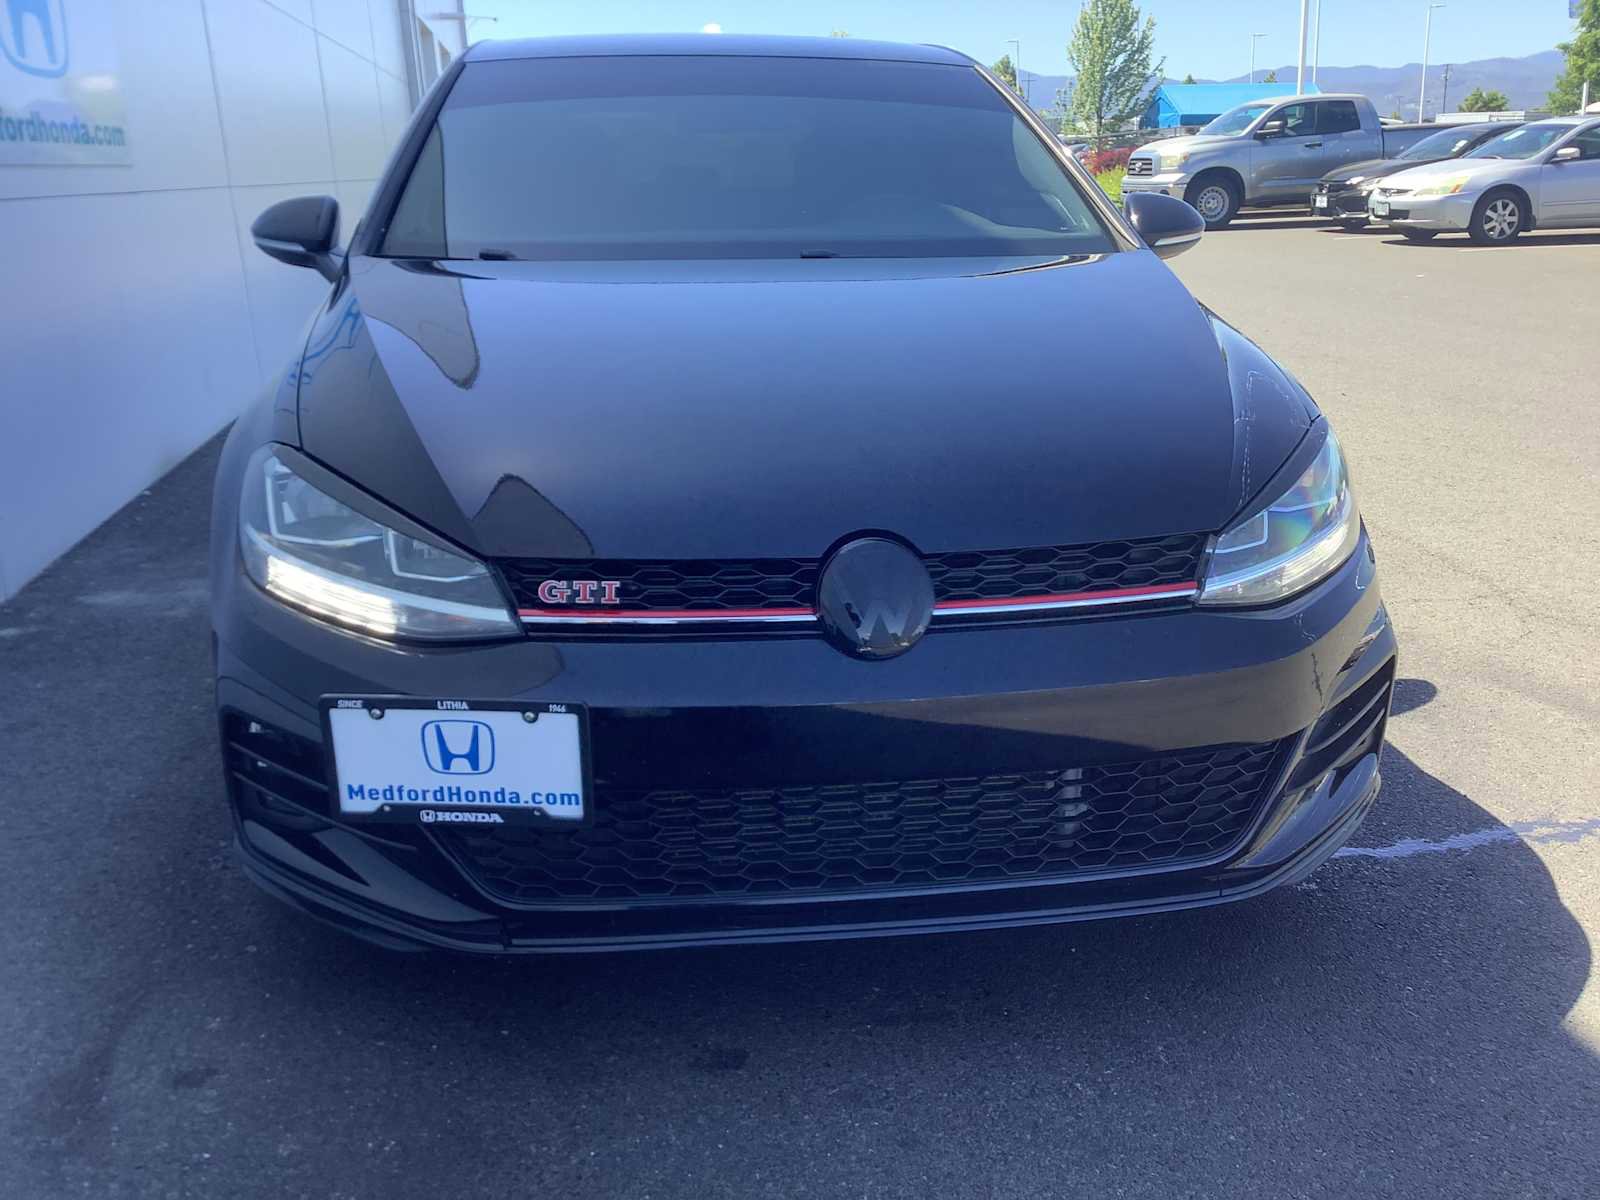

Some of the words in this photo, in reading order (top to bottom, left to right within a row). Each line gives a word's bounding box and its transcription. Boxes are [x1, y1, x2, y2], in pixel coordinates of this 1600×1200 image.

[538, 580, 620, 604] GTI
[337, 699, 363, 709] SINCE
[436, 700, 469, 710] LITHIA
[347, 784, 580, 806] MedfordHonda.com
[436, 811, 504, 823] HONDA
